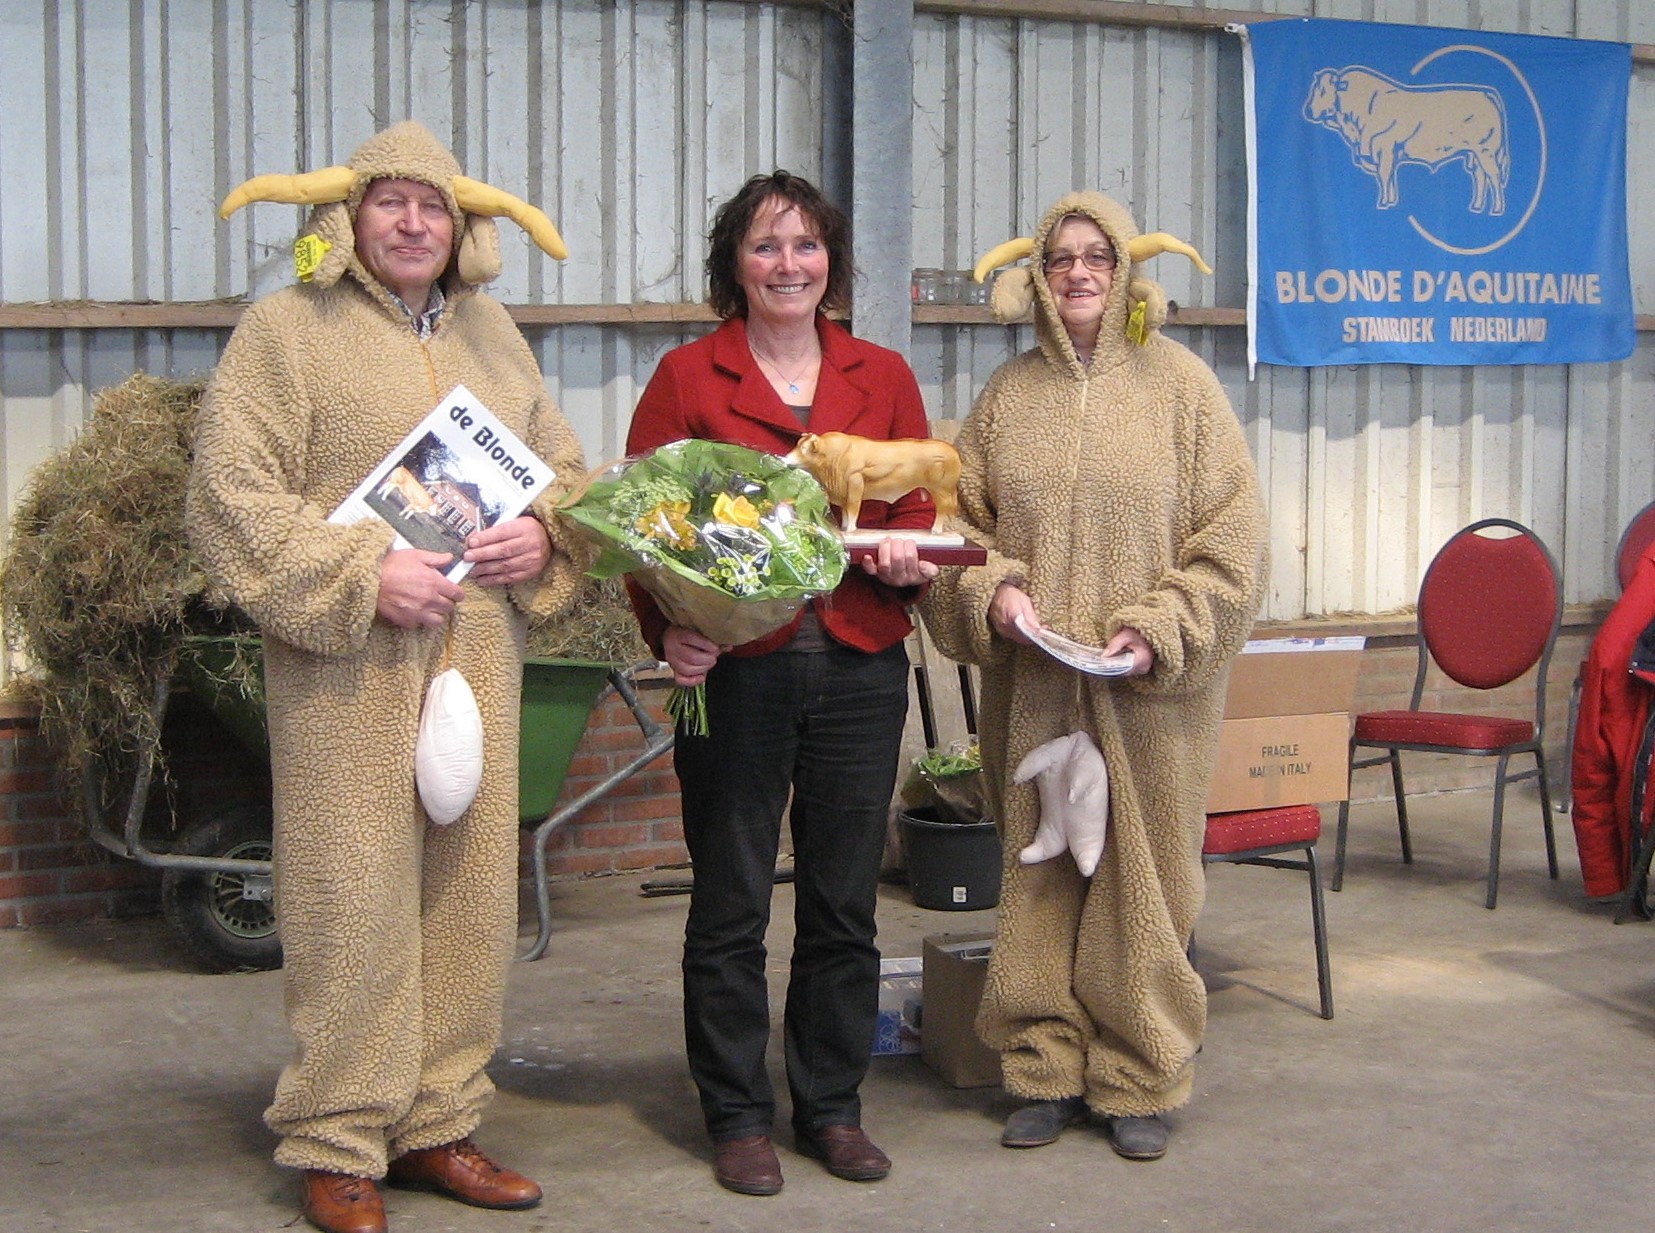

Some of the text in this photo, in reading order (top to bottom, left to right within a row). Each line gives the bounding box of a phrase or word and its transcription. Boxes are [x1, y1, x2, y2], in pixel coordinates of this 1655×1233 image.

[1276, 269, 1602, 304] BLONDE D'AQUITAINE
[1450, 317, 1547, 342] NEDERLAND
[450, 405, 474, 430] de
[472, 426, 535, 490] Blonde
[1261, 744, 1299, 758] FRAGILE
[1287, 761, 1312, 776] ITALY
